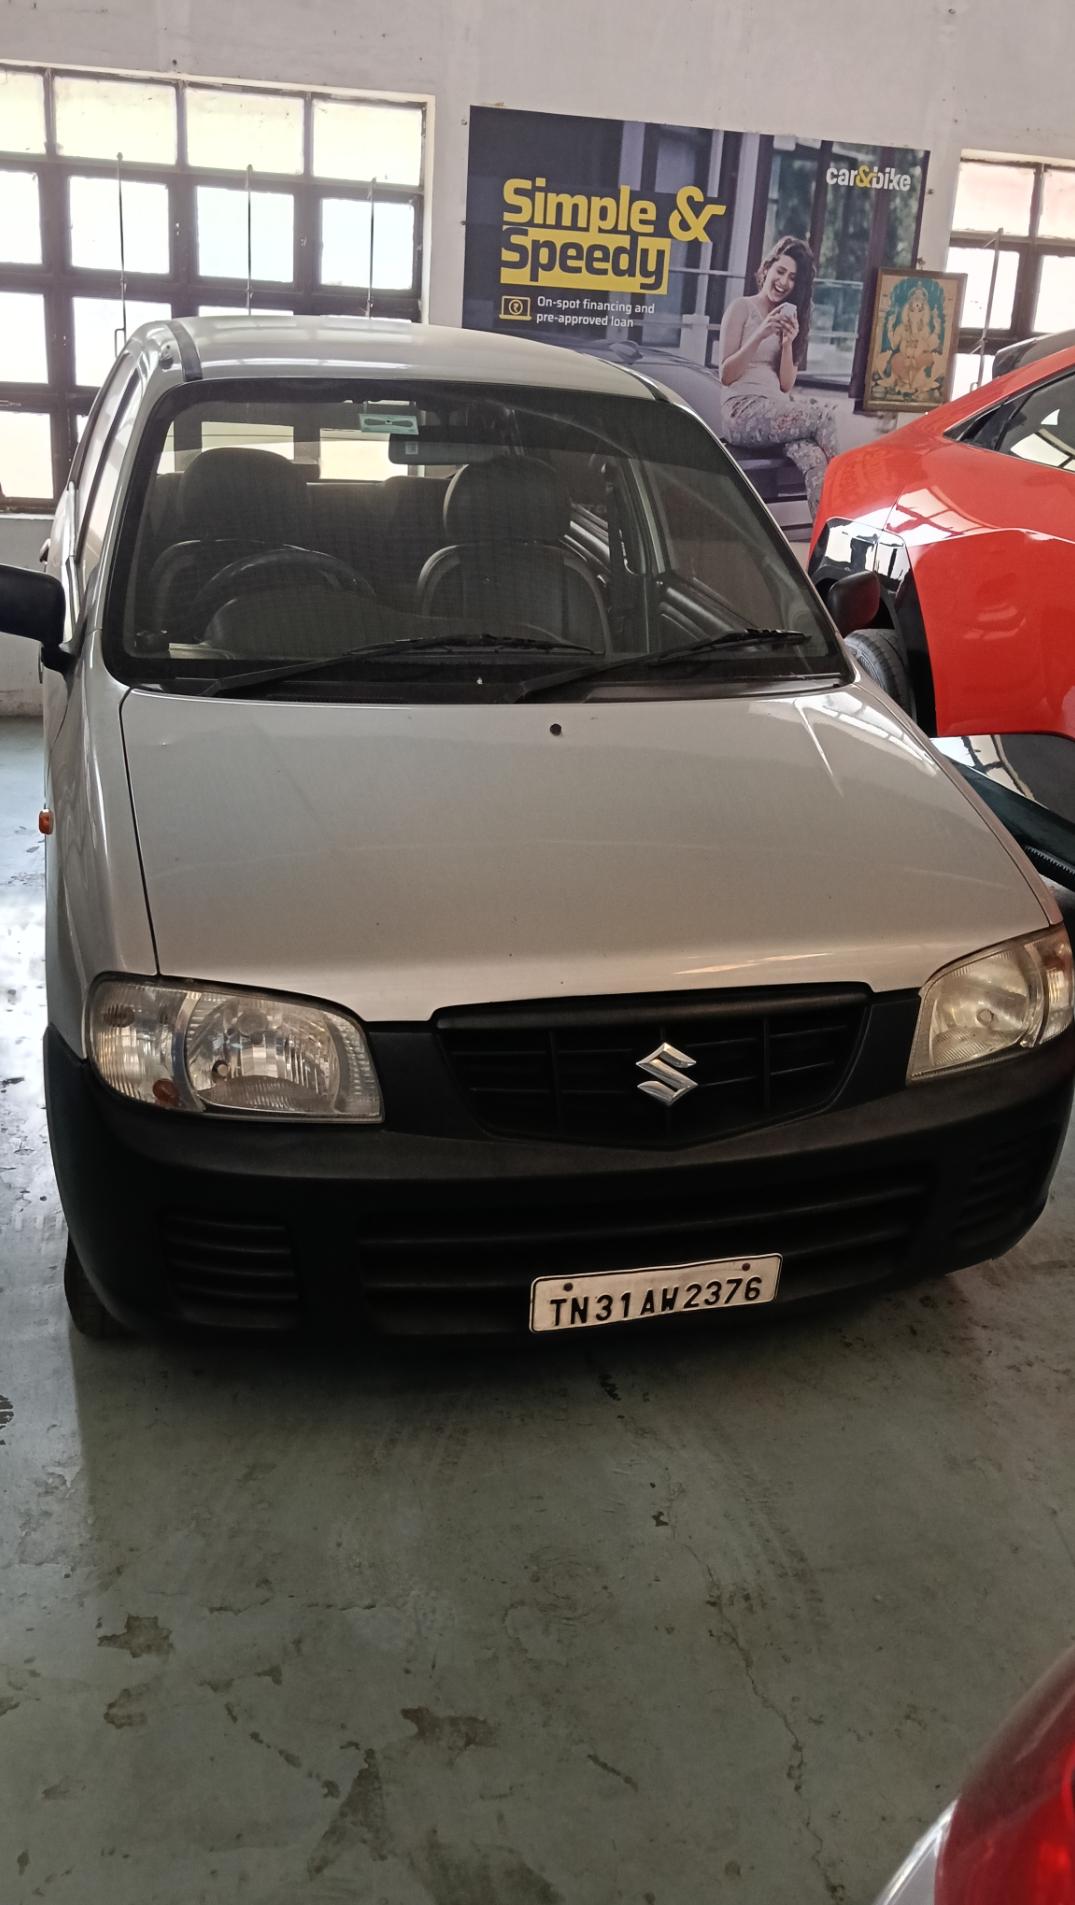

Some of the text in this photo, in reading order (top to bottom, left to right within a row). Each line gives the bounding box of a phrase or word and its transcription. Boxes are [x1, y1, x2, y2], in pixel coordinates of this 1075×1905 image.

[826, 165, 912, 191] car&bike
[502, 177, 727, 243] Simple &
[501, 226, 666, 291] Speedy
[536, 313, 634, 328] pre-approved loan
[537, 295, 656, 315] On-spot financing and
[550, 1276, 763, 1327] TN31AW2376
